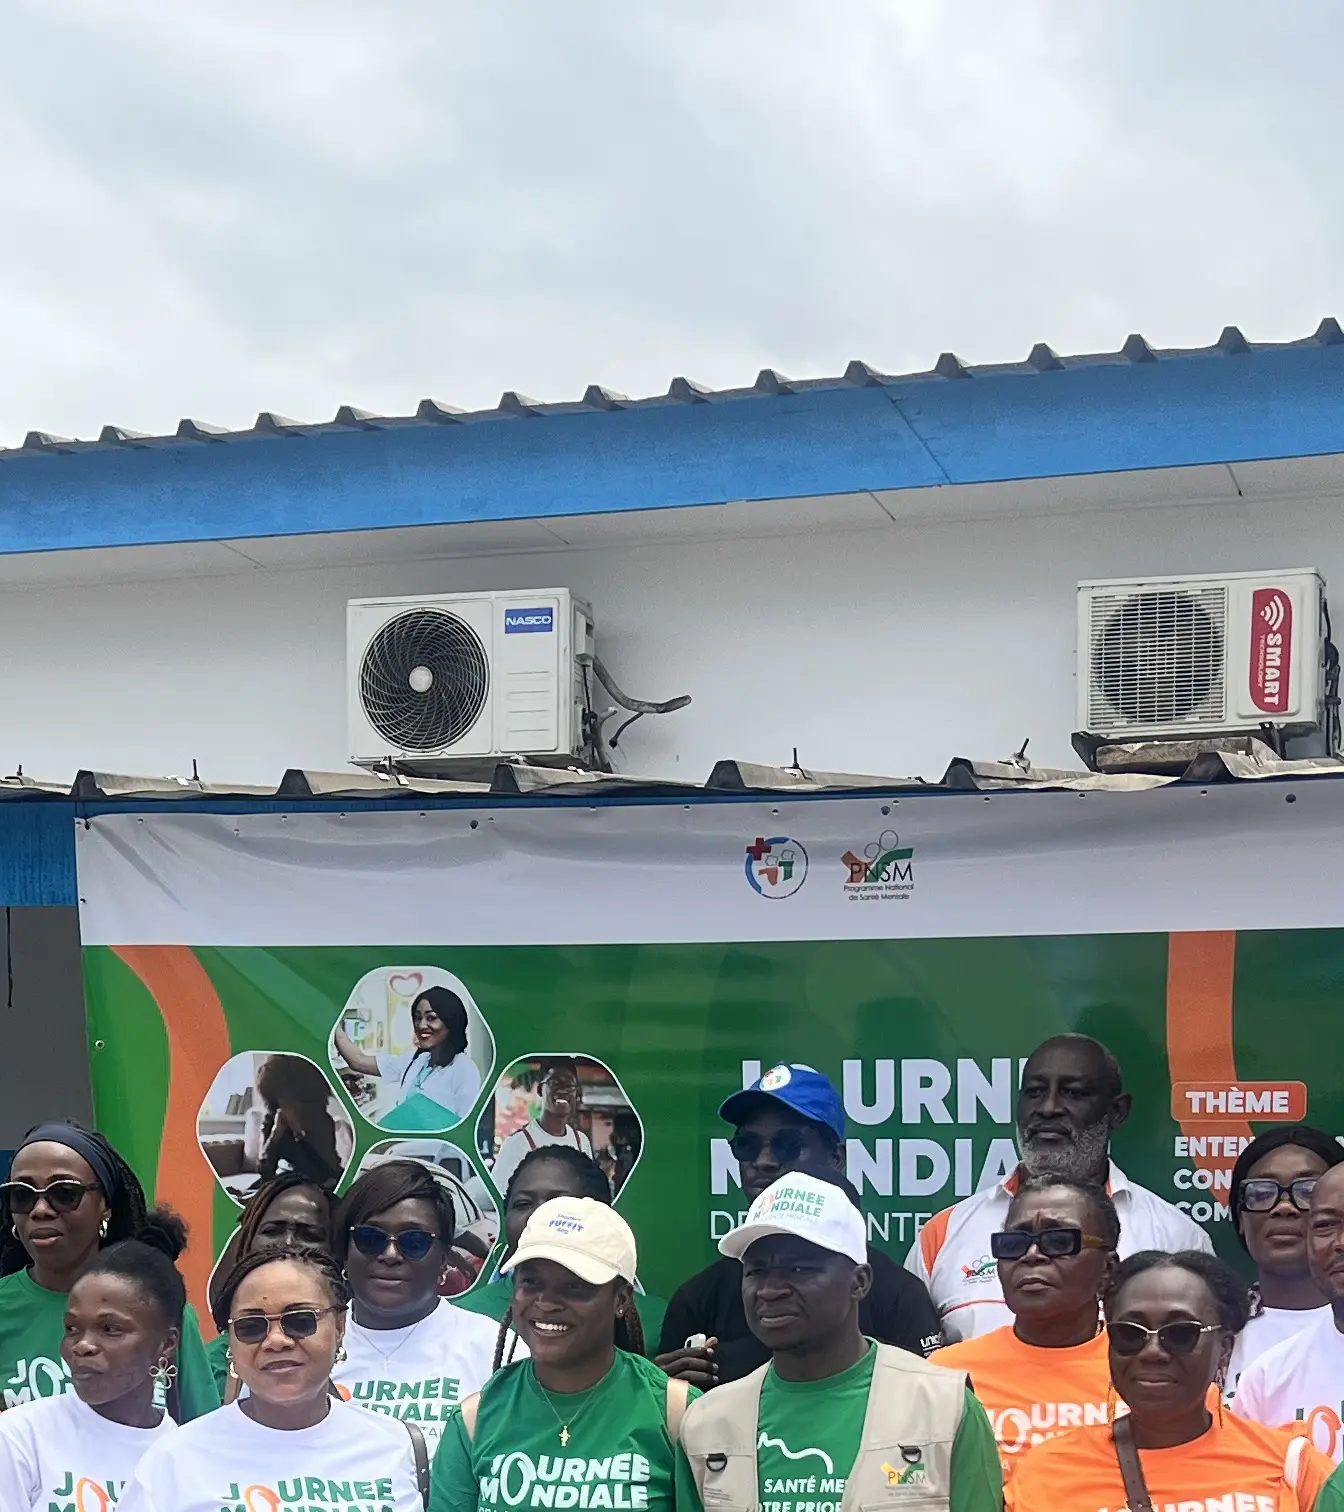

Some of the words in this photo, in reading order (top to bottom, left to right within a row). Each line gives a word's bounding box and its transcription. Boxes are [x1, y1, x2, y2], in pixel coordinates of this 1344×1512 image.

[506, 615, 551, 626] NASCO
[1264, 633, 1282, 705] SMART
[850, 862, 913, 882] PNSM
[1186, 1087, 1289, 1114] THÈME
[1174, 1136, 1254, 1158] ENTEN
[490, 1452, 650, 1483] JOURNEE
[888, 1471, 928, 1485] PNSM
[221, 1476, 395, 1503] JOURNEE
[479, 1476, 648, 1509] MONDIALE
[764, 1475, 816, 1493] SANTÉ
